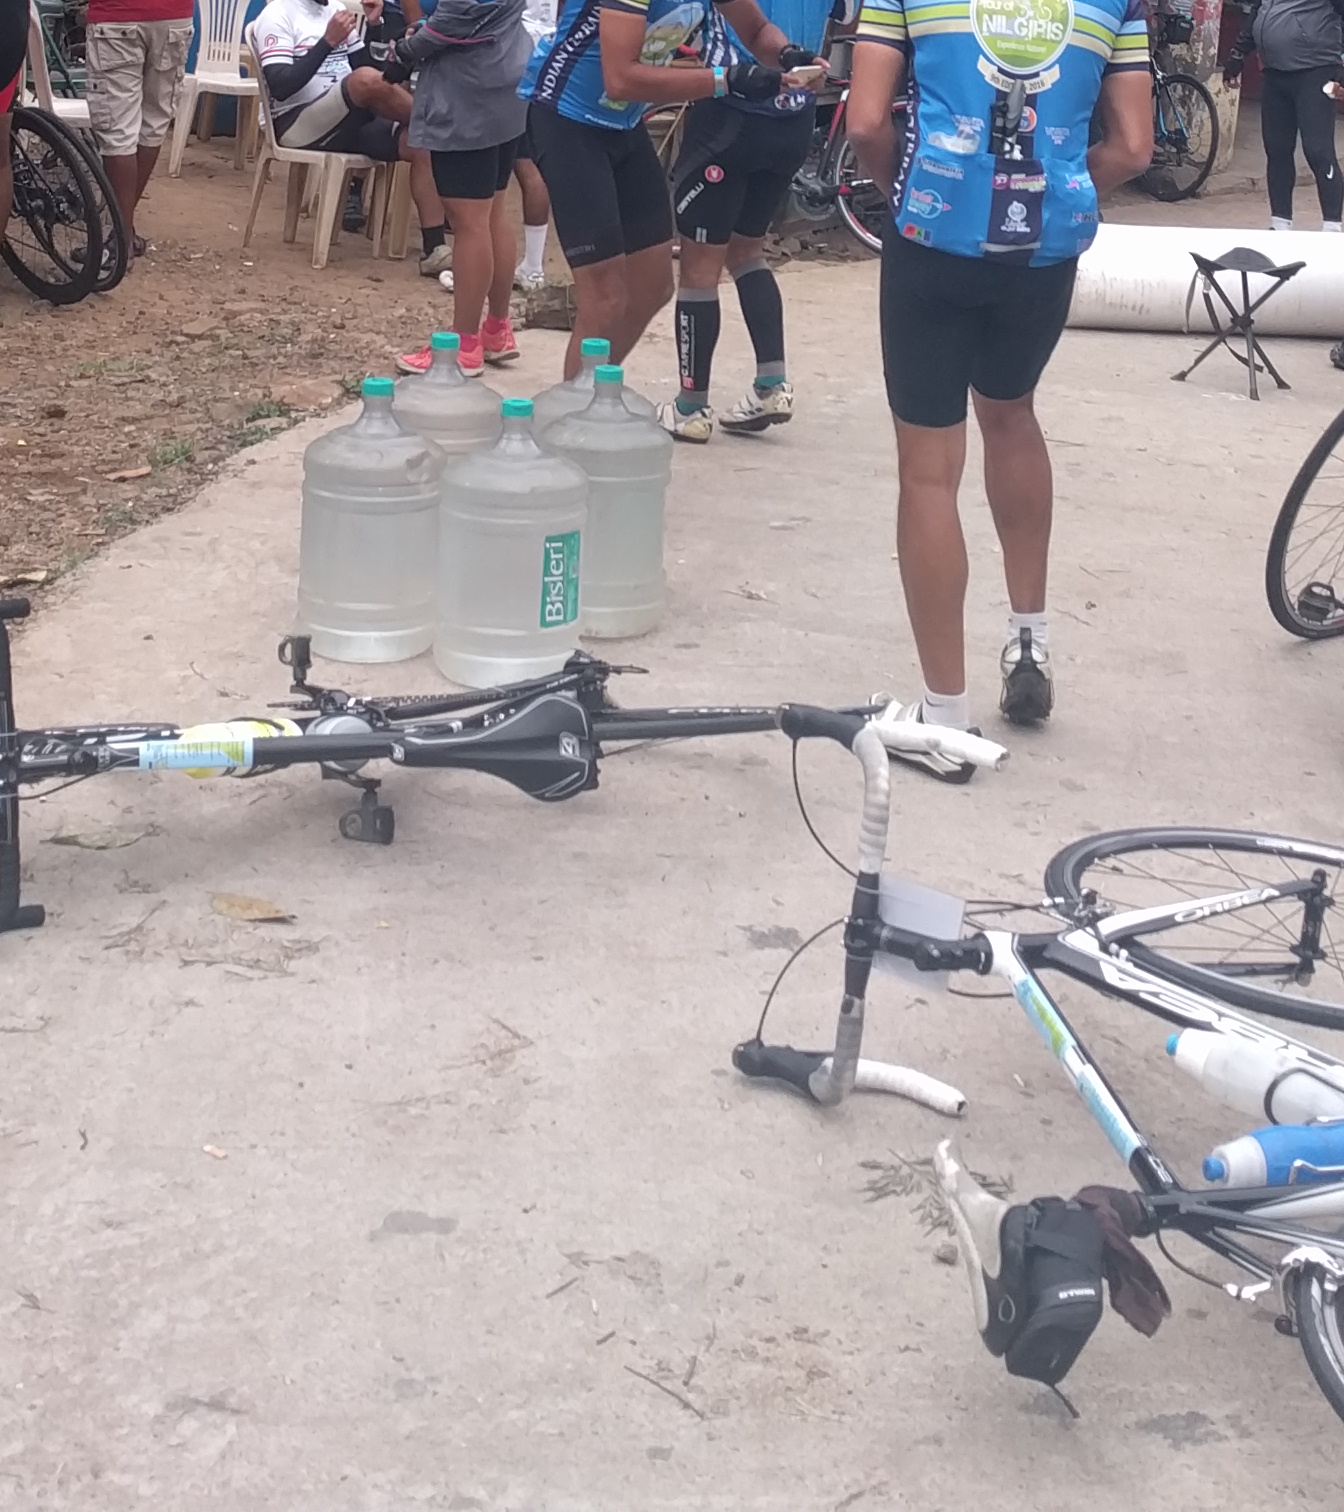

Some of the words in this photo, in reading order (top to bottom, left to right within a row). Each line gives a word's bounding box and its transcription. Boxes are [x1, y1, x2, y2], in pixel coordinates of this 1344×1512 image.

[982, 13, 1064, 41] NILGIRIS
[544, 541, 564, 623] Bisleri
[1173, 887, 1281, 924] ORBEA
